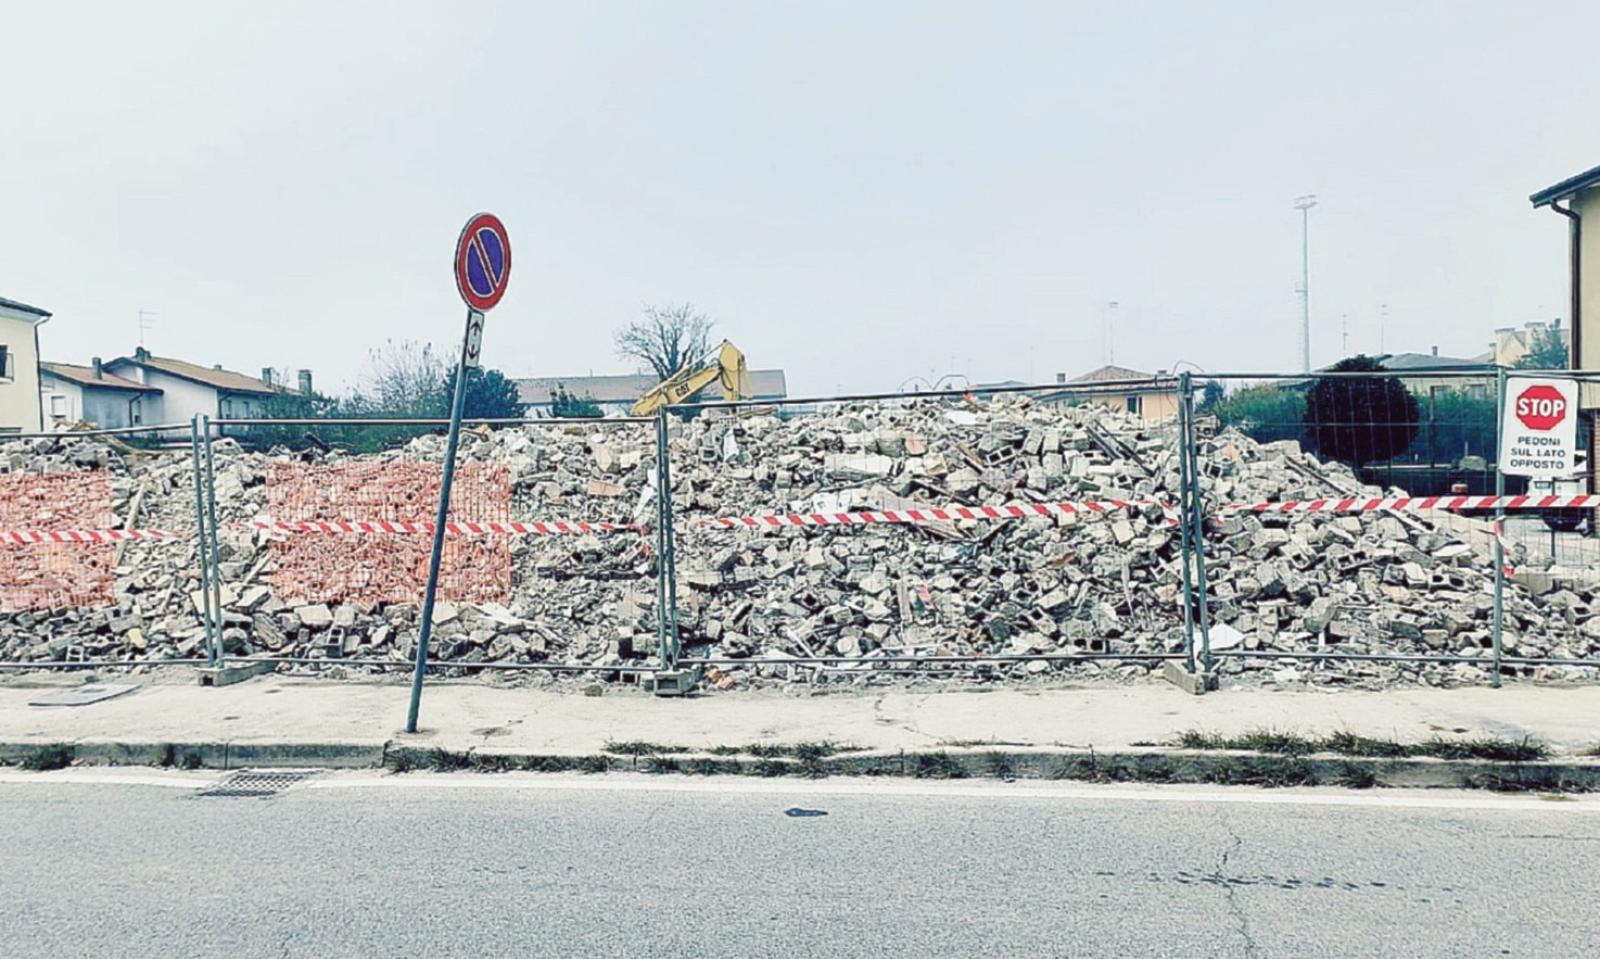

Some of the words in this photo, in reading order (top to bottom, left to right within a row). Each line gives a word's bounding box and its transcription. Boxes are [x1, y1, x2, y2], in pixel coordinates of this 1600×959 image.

[1517, 398, 1564, 417] STOP
[1517, 436, 1560, 446] PEDONI
[1511, 448, 1532, 457] SUL
[1537, 449, 1565, 458] LATO
[1510, 459, 1564, 469] OPPOSTO
